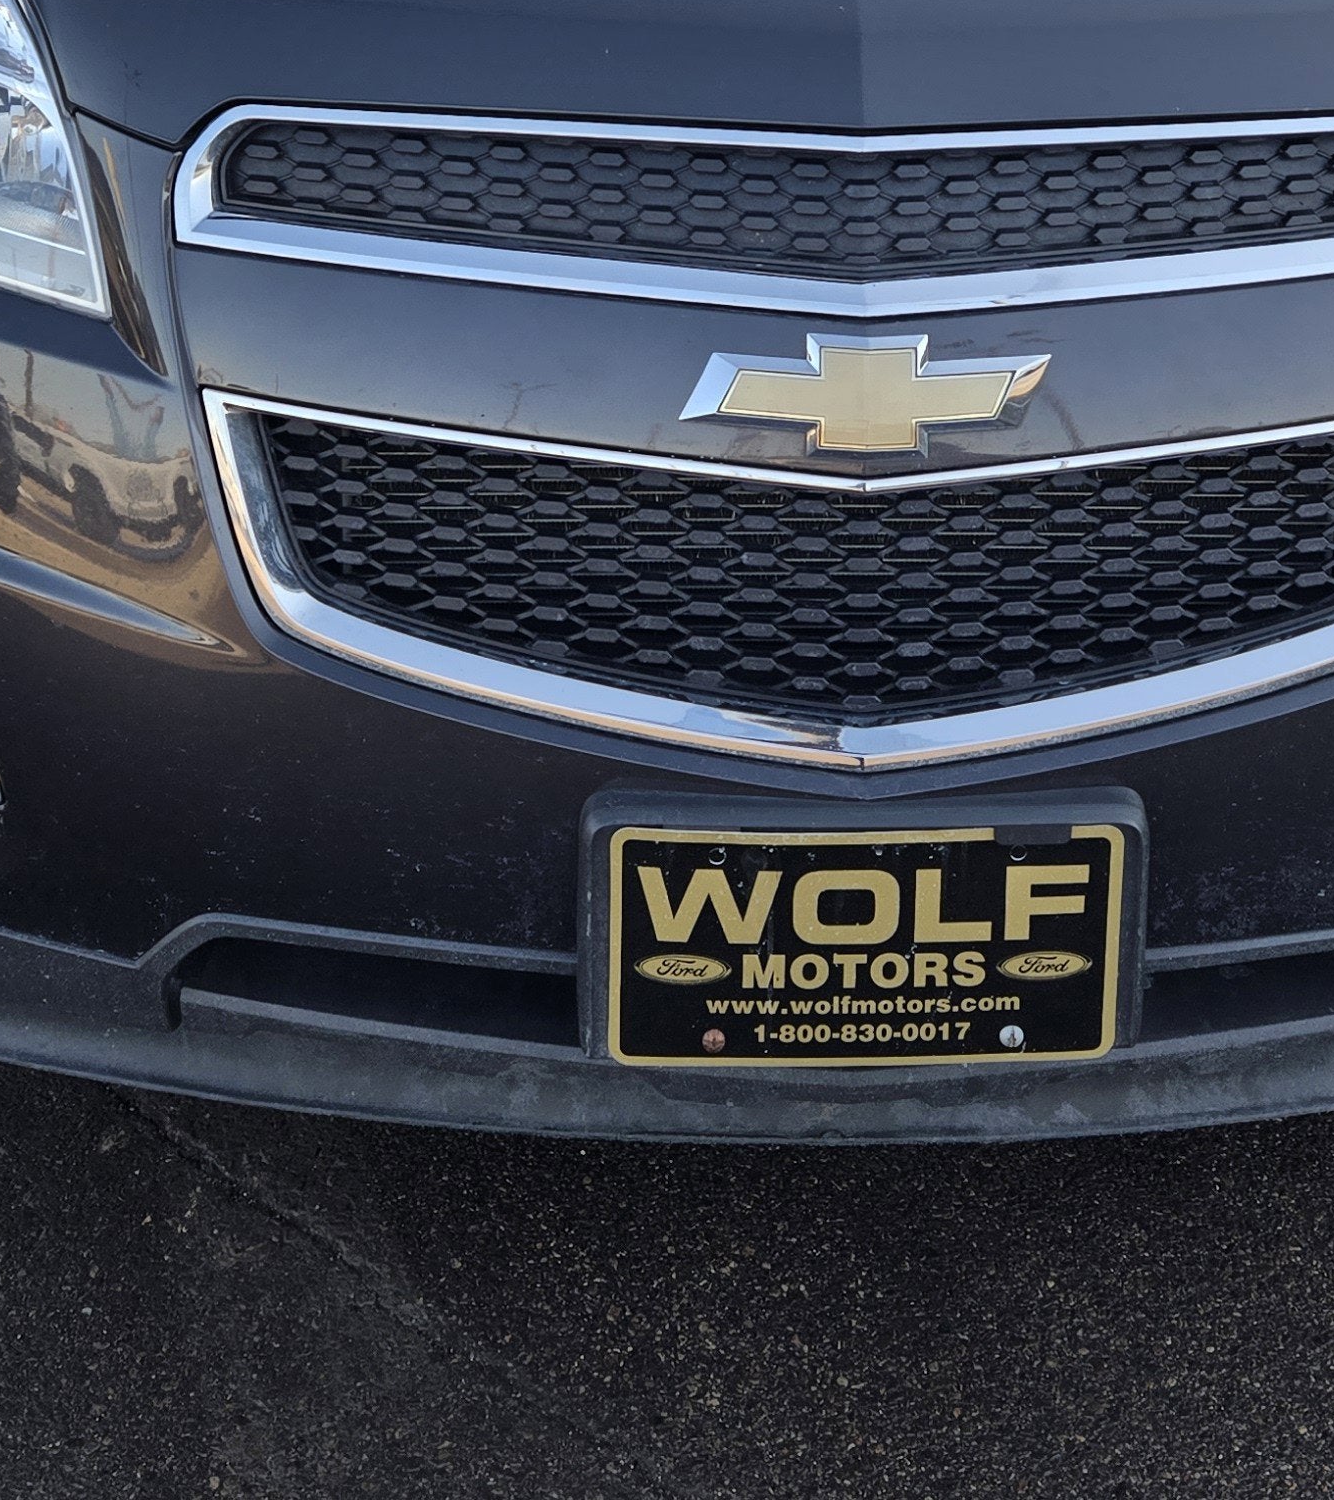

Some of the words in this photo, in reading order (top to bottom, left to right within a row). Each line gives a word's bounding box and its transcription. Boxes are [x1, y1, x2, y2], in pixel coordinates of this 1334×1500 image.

[637, 864, 1091, 946] WOLF
[741, 951, 987, 989] MOTORS
[706, 995, 1021, 1015] www.wolfmotors.com
[753, 1022, 972, 1044] 1-800-830-0017
